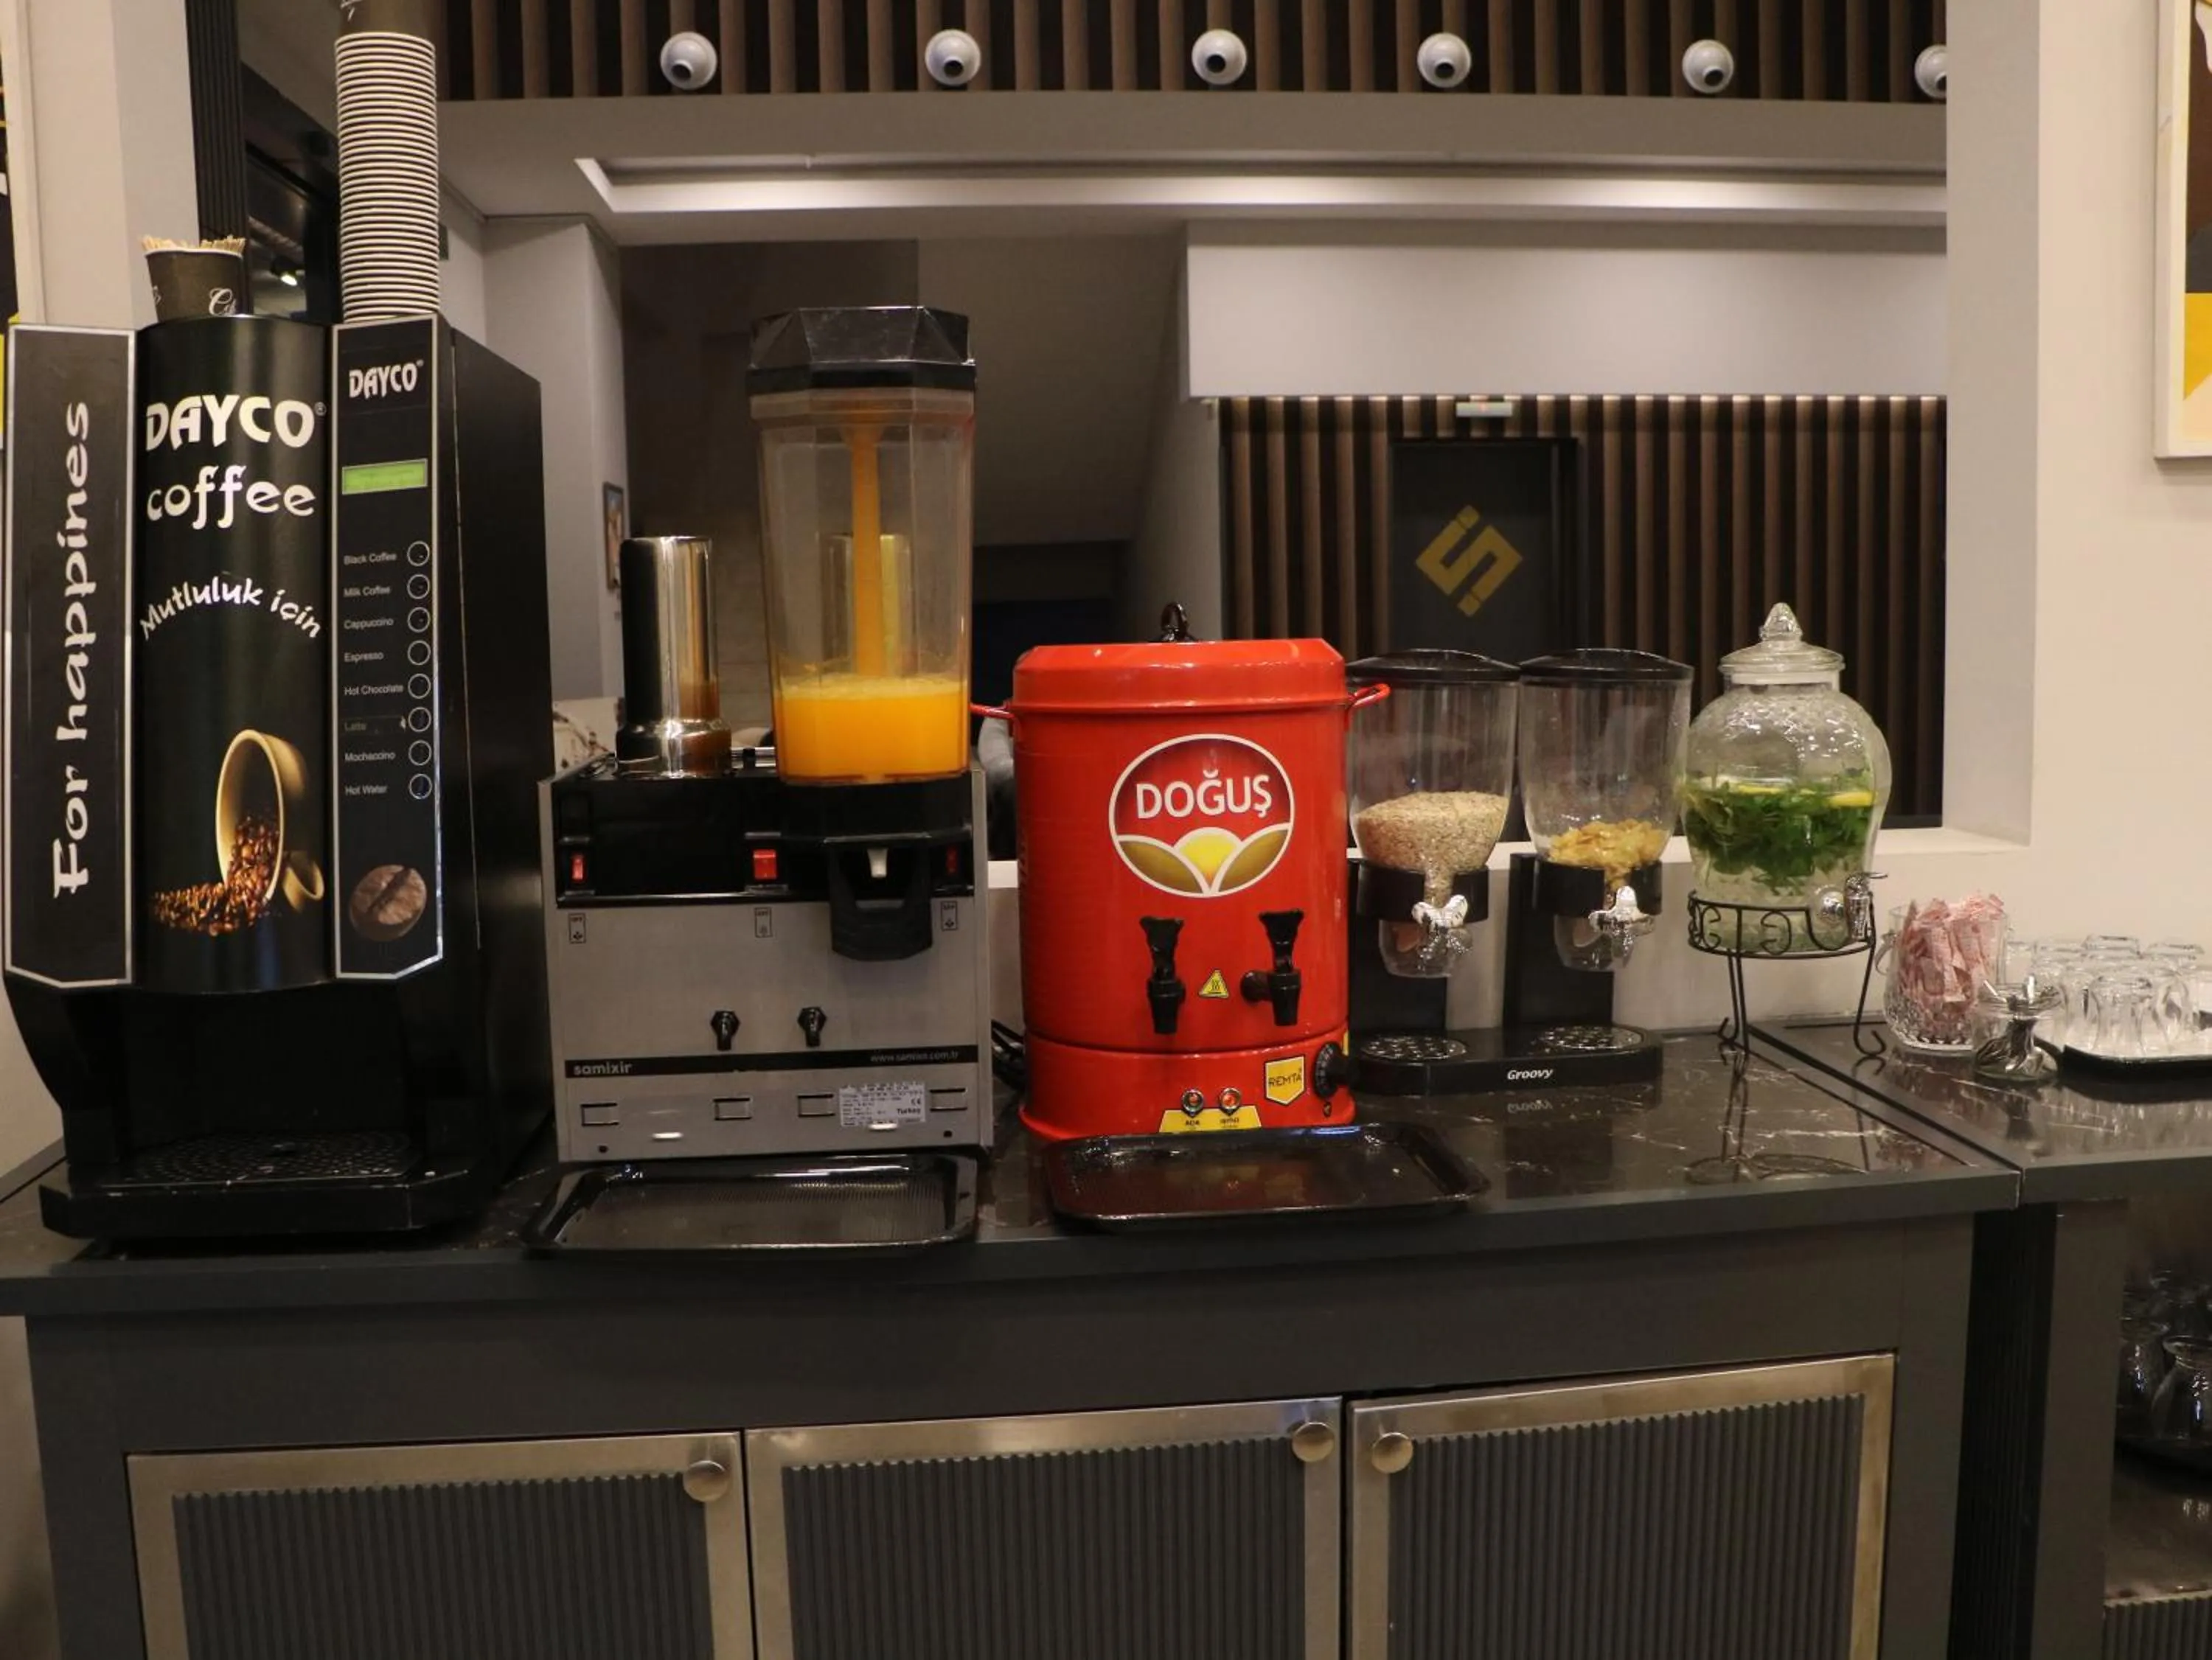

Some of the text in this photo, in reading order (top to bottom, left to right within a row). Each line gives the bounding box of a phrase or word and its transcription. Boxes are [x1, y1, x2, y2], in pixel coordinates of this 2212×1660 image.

[349, 363, 417, 400] DAYCO
[146, 394, 315, 452] DAYCO
[147, 464, 316, 530] coffee
[344, 552, 397, 565] Black Coffee
[344, 585, 391, 598] Milk Coffee
[139, 576, 264, 641] Mutluluk
[344, 618, 394, 630] Cappuccino
[52, 402, 97, 899] For happines
[344, 651, 384, 663] Espresso
[344, 684, 404, 697] Hot Chocolate
[345, 784, 388, 795] Hot Water
[1136, 769, 1273, 819] DOĞUŞ
[574, 1061, 632, 1075] samixir
[1507, 1069, 1554, 1080] Groovy
[1268, 1073, 1301, 1087] REMTA
